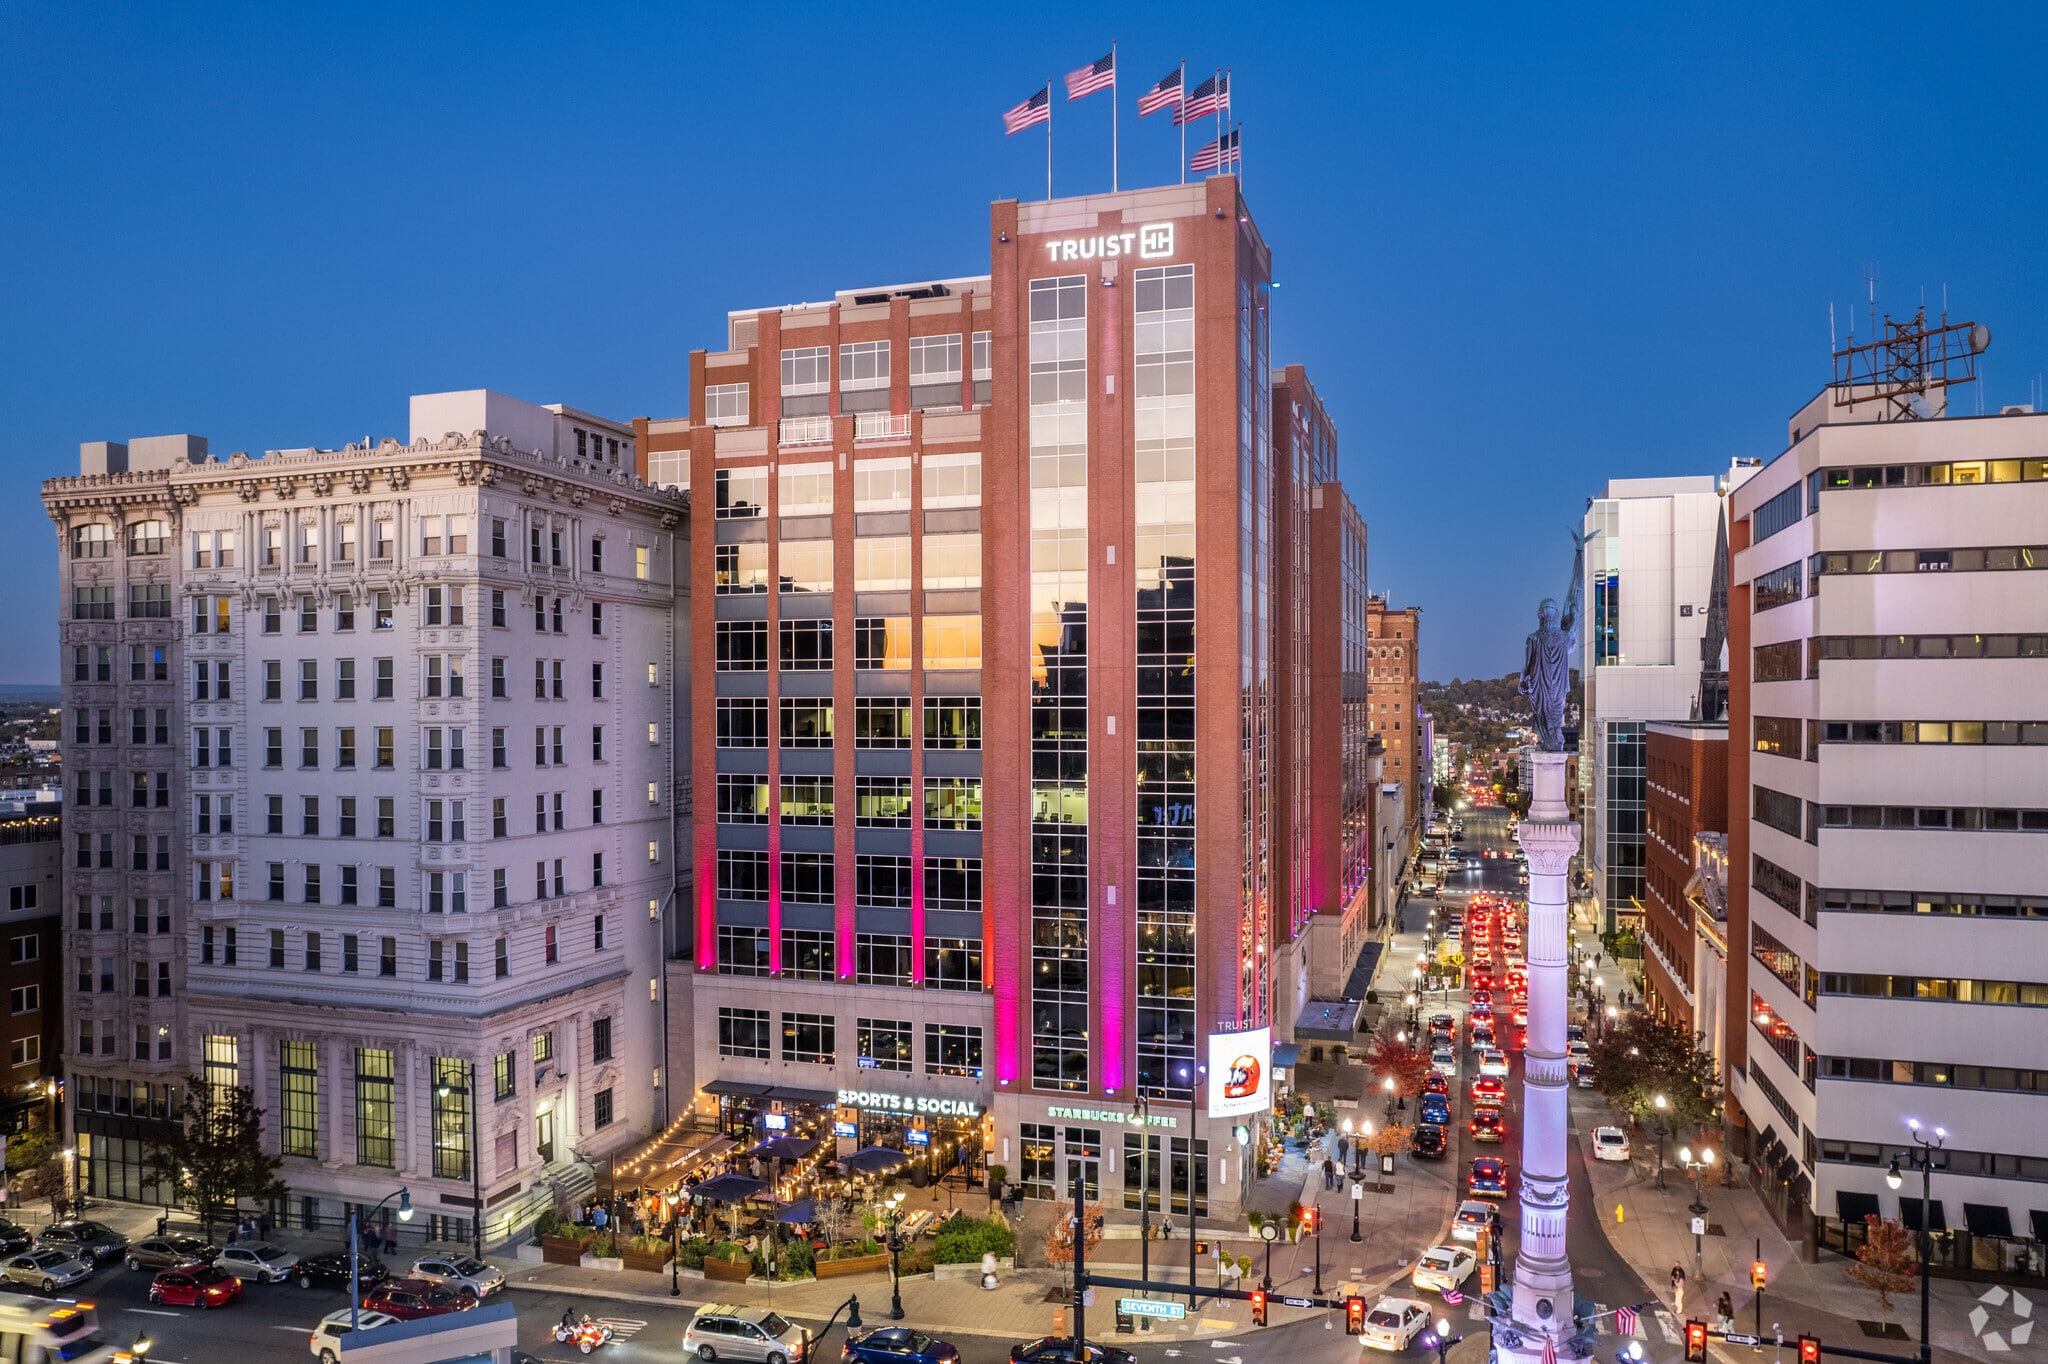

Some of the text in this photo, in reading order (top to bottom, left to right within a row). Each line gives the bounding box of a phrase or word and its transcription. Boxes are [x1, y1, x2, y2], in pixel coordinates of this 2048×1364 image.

[1046, 233, 1136, 261] TRUIST
[1217, 1018, 1255, 1032] TRUIST
[838, 1089, 900, 1108] SPORTS
[903, 1097, 914, 1111] &
[917, 1098, 979, 1117] SOCIAL
[1048, 1106, 1177, 1128] STARBUCKS CFFEE
[1125, 1302, 1167, 1314] SEVENTH
[1170, 1306, 1181, 1315] ST
